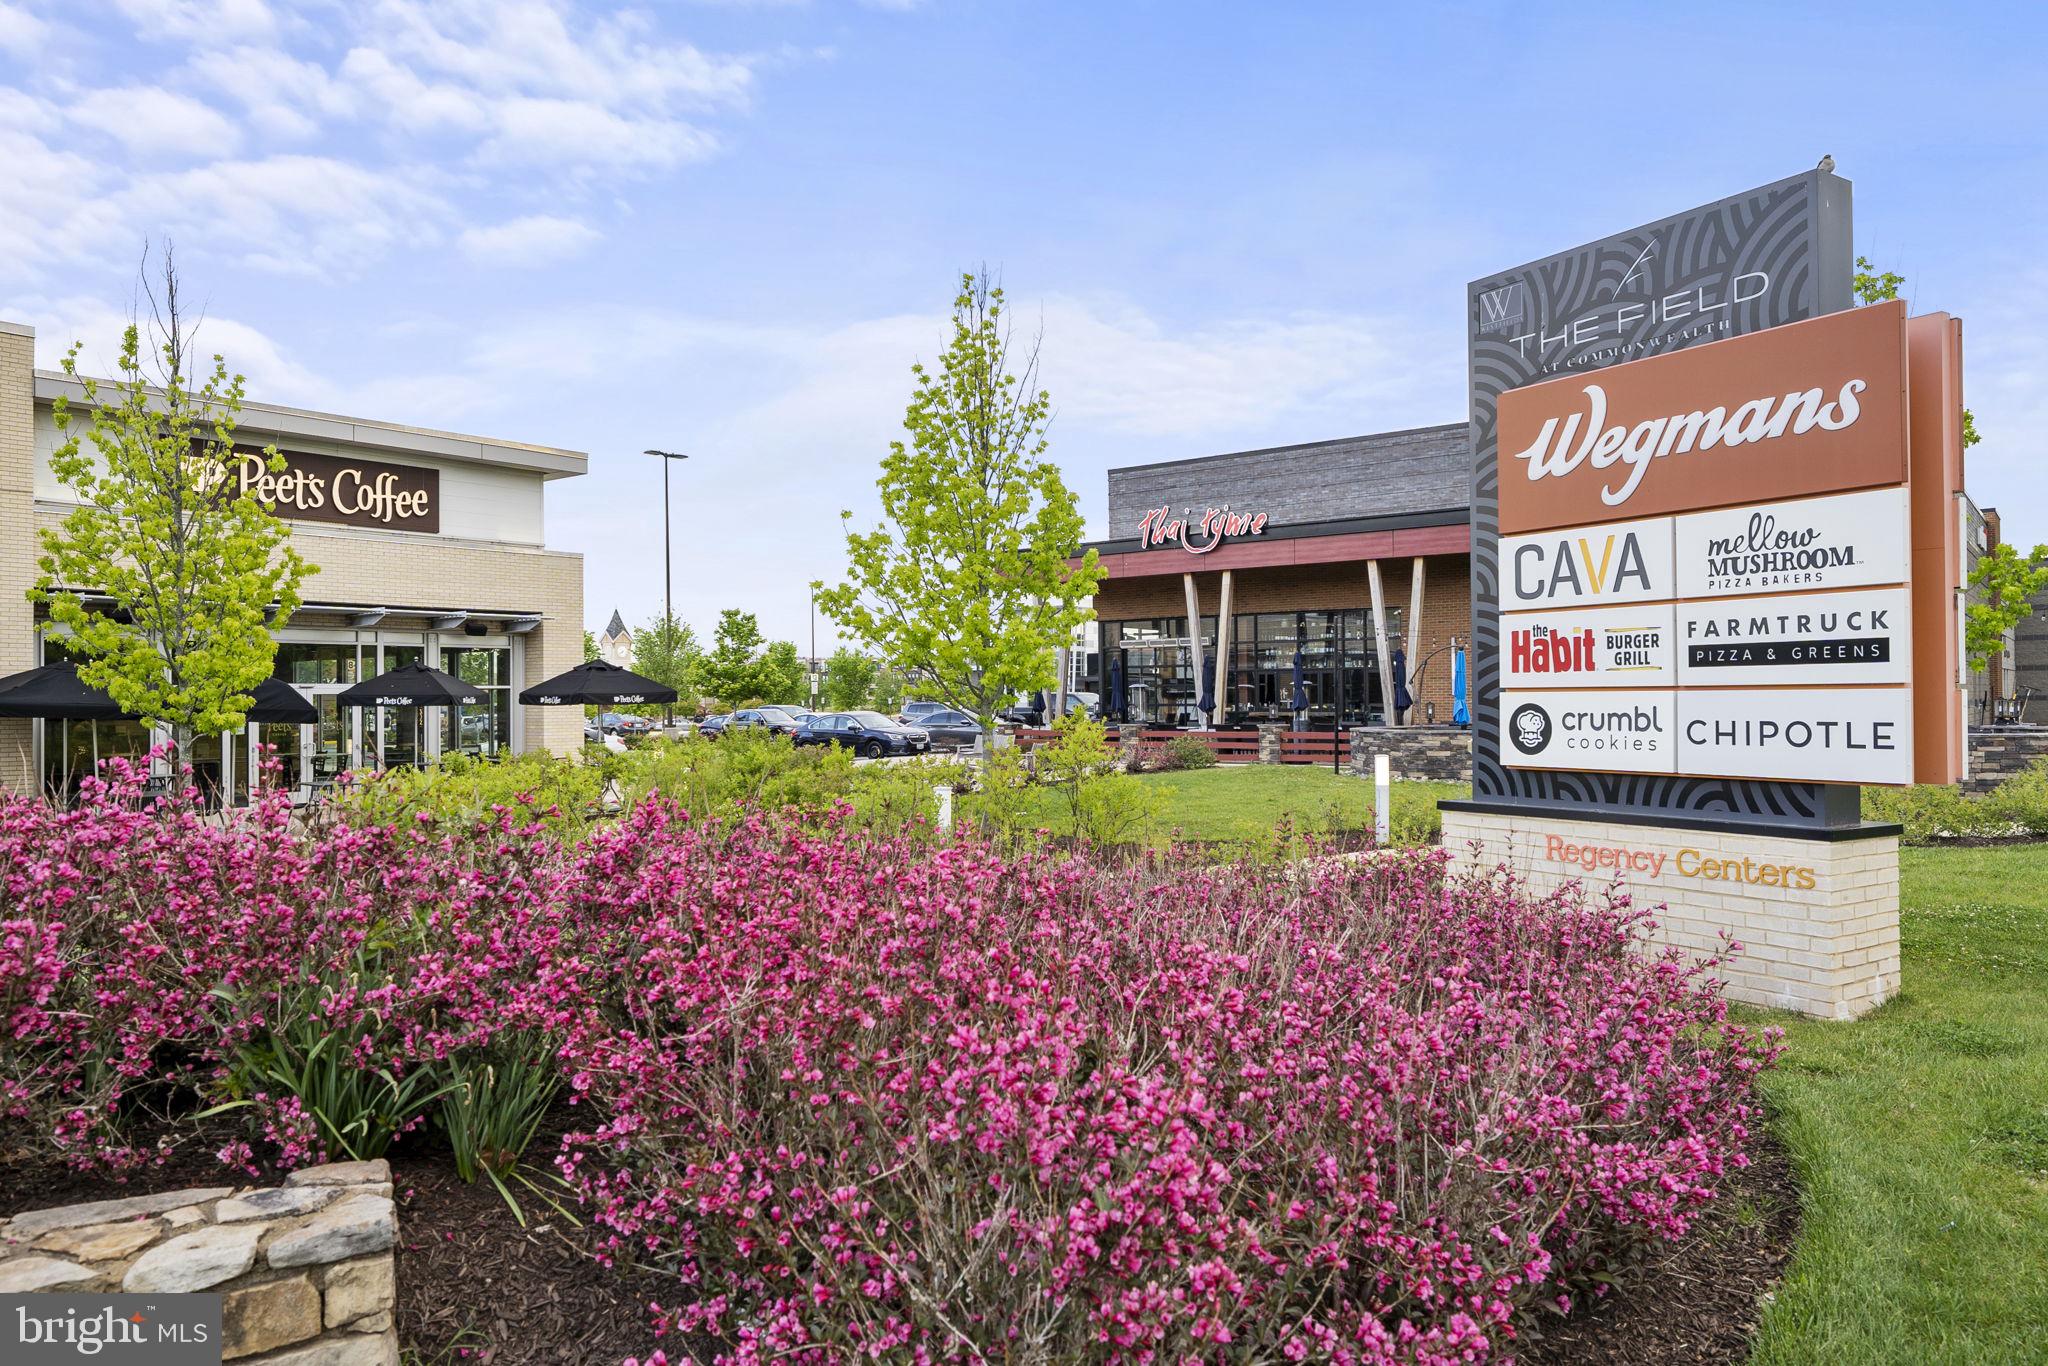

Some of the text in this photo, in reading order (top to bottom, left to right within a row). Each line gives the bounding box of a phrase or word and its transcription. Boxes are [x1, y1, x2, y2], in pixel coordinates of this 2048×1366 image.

[1508, 271, 1770, 359] THE FIELD
[1540, 318, 1731, 376] AT COMMONWEALTH
[1514, 379, 1867, 507] Wegmans
[331, 467, 429, 523] Coffee
[1707, 511, 1822, 557] mellow
[1514, 532, 1652, 600] CAVA
[1707, 545, 1856, 578] MUSHROOM
[1708, 572, 1823, 590] PIZZA BAKERS
[1532, 624, 1548, 638] the
[1687, 609, 1889, 639] FARMTRUCK
[1511, 626, 1596, 674] Habit
[1606, 633, 1660, 650] BURGER
[1696, 644, 1880, 662] PIZZA & GREENS
[1614, 651, 1651, 666] GRILL
[1561, 705, 1663, 733] crumbl
[1686, 719, 1895, 750] CHIPOTLE
[1567, 734, 1657, 751] cookies
[1545, 833, 1816, 890] Regency Centers
